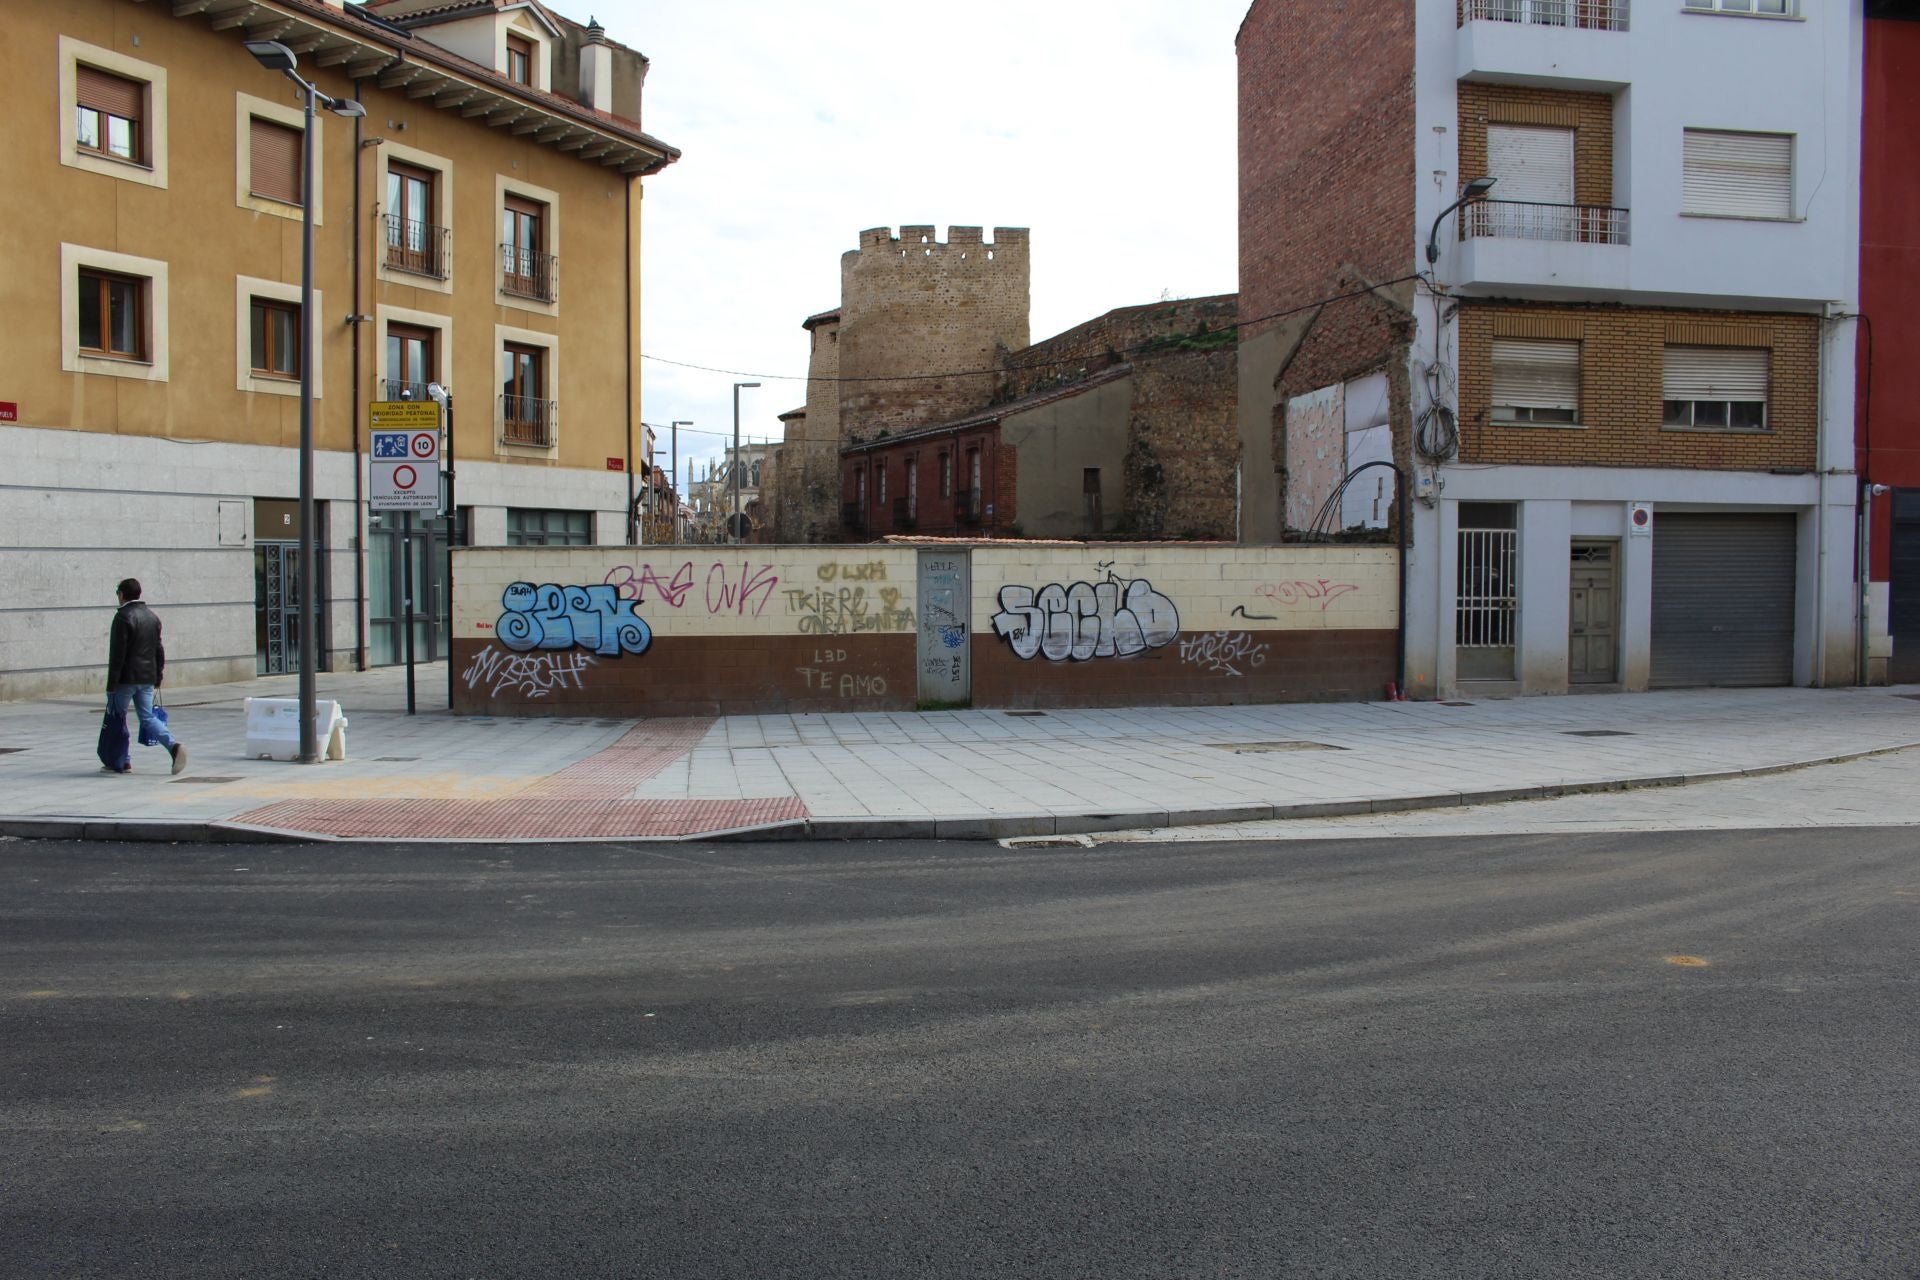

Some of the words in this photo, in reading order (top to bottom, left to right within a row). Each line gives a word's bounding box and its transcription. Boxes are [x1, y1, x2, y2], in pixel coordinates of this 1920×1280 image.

[417, 441, 429, 450] 10
[795, 667, 833, 689] TE
[840, 673, 888, 698] AMO
